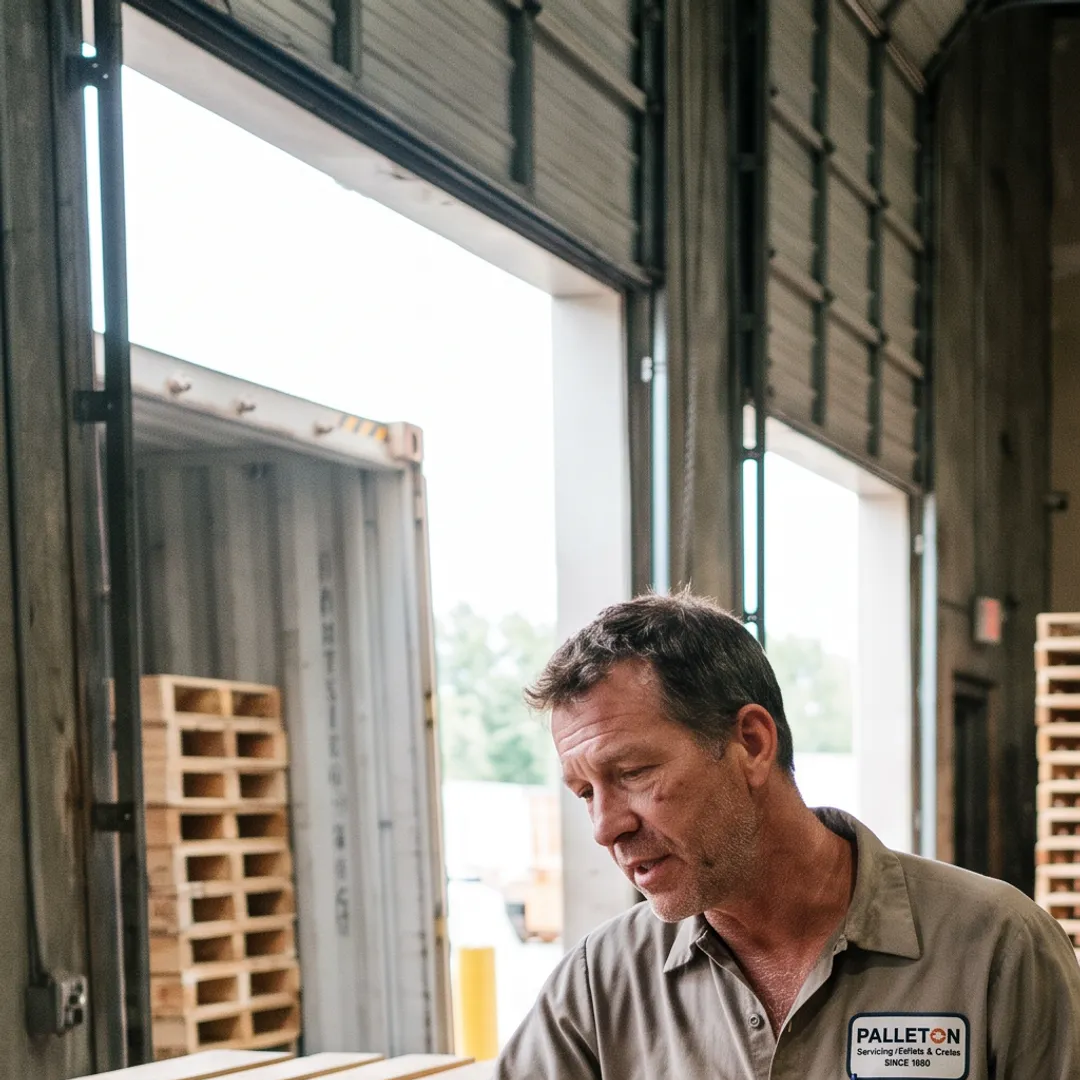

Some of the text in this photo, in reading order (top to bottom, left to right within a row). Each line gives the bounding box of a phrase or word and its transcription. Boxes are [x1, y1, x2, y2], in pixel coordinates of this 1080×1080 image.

[857, 1027, 960, 1044] PALLETON
[927, 1048, 933, 1056] &
[884, 1058, 909, 1067] SINCE
